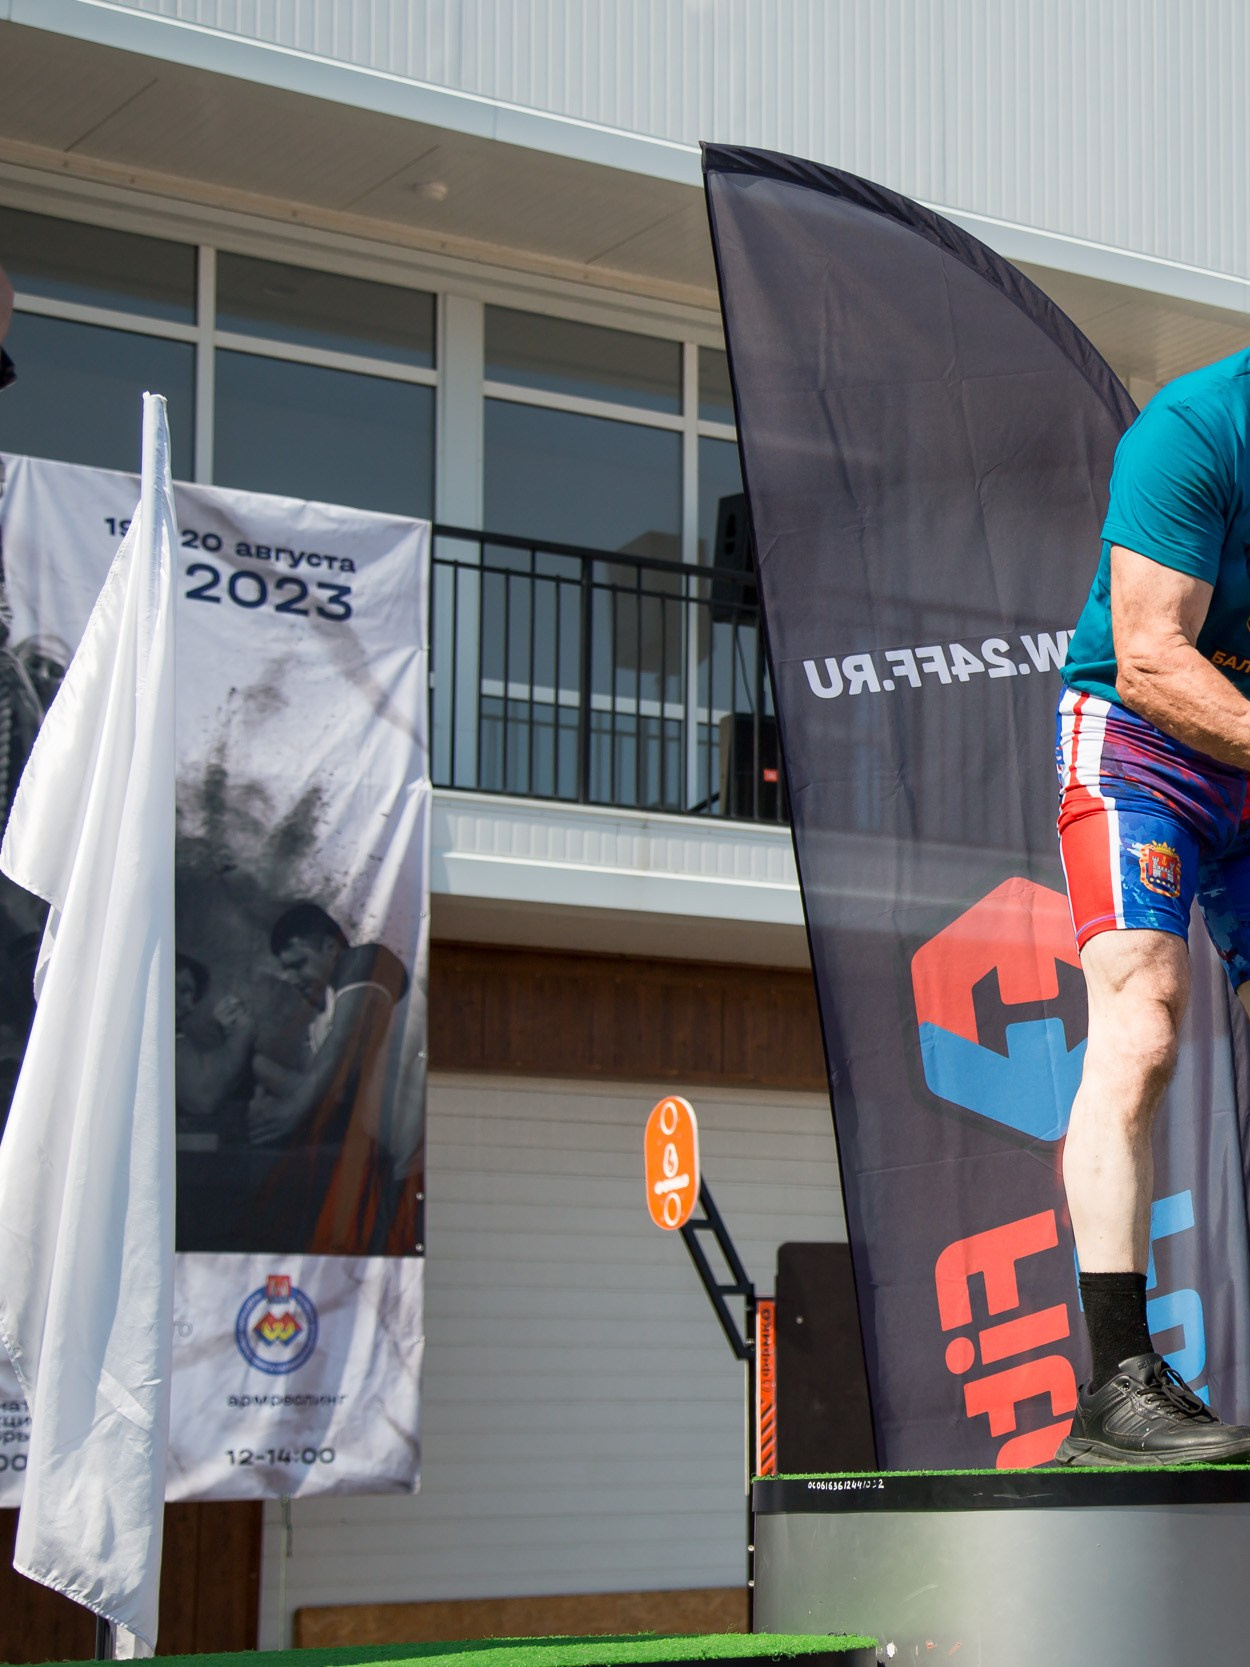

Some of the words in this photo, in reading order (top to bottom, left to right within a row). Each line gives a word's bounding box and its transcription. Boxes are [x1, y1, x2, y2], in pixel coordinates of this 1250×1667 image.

[181, 529, 223, 553] 20
[235, 542, 357, 573] августа
[185, 563, 353, 622] 2023
[225, 1447, 336, 1465] 12-14:00
